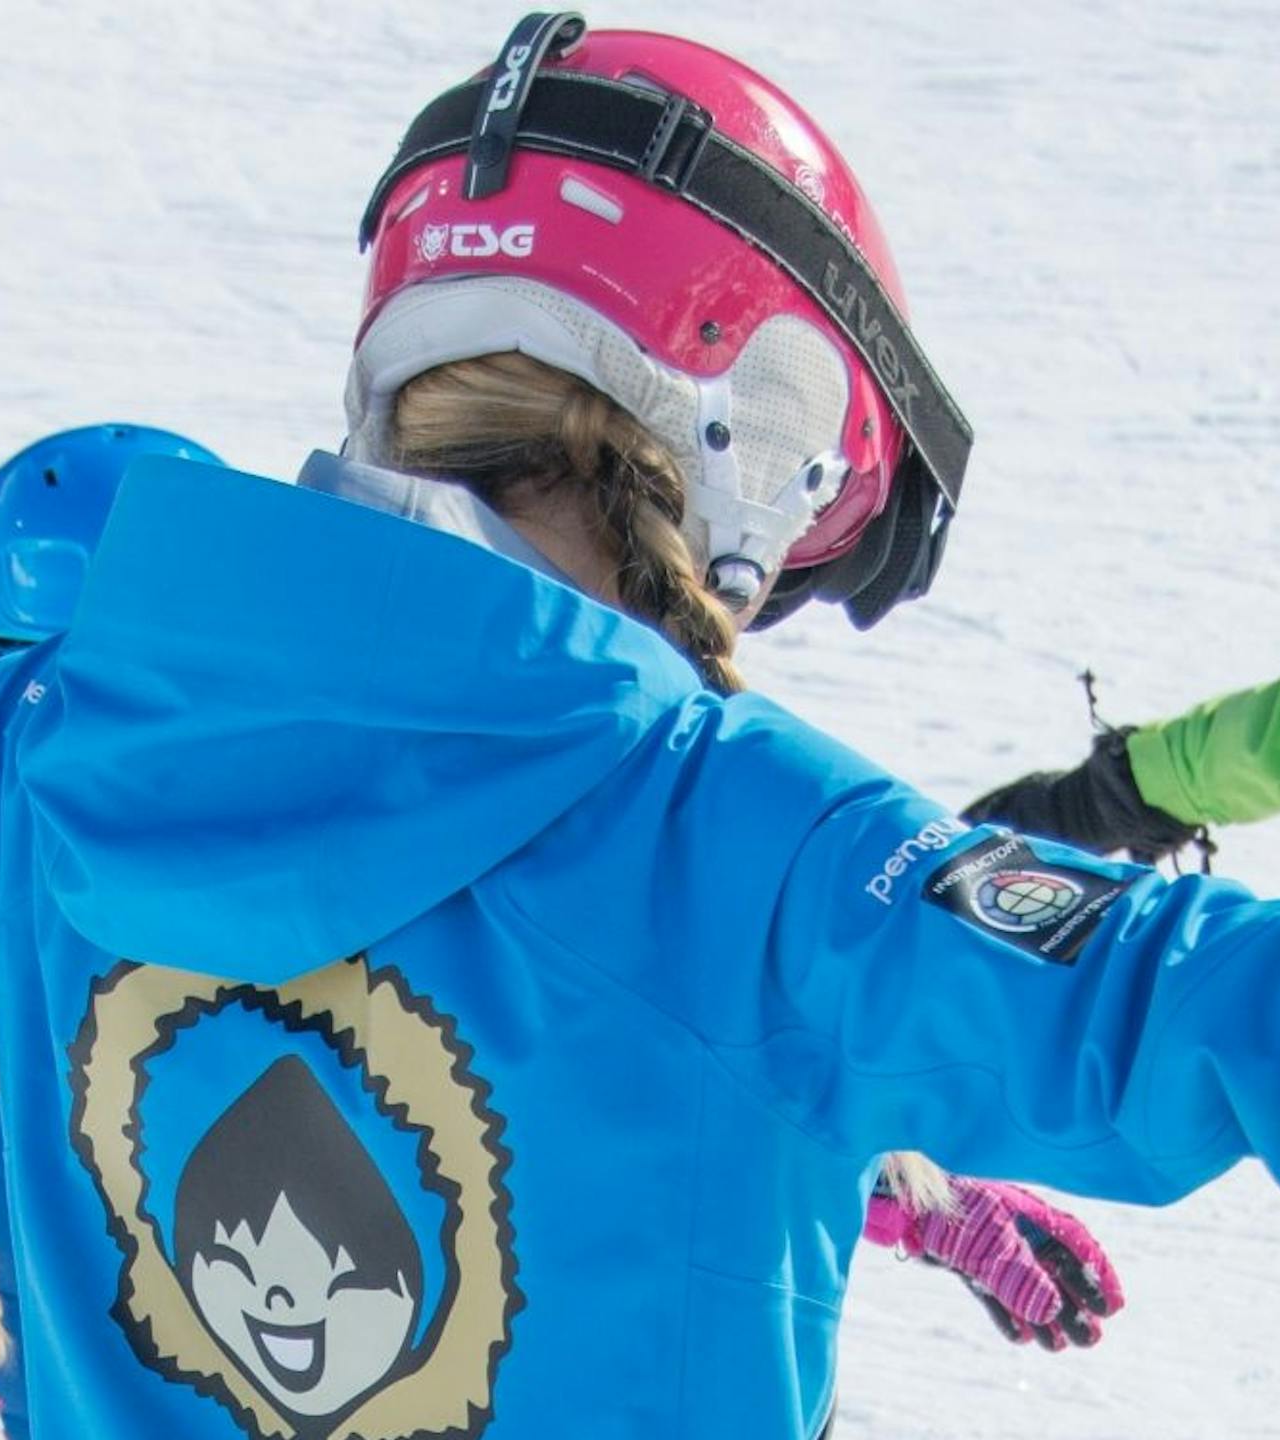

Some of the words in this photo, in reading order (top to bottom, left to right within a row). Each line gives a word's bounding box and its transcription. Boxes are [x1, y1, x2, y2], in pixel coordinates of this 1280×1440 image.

[487, 45, 531, 112] TSG
[450, 223, 535, 258] TSG
[823, 260, 919, 425] uvex
[932, 837, 1021, 895] INSTRUCTOR
